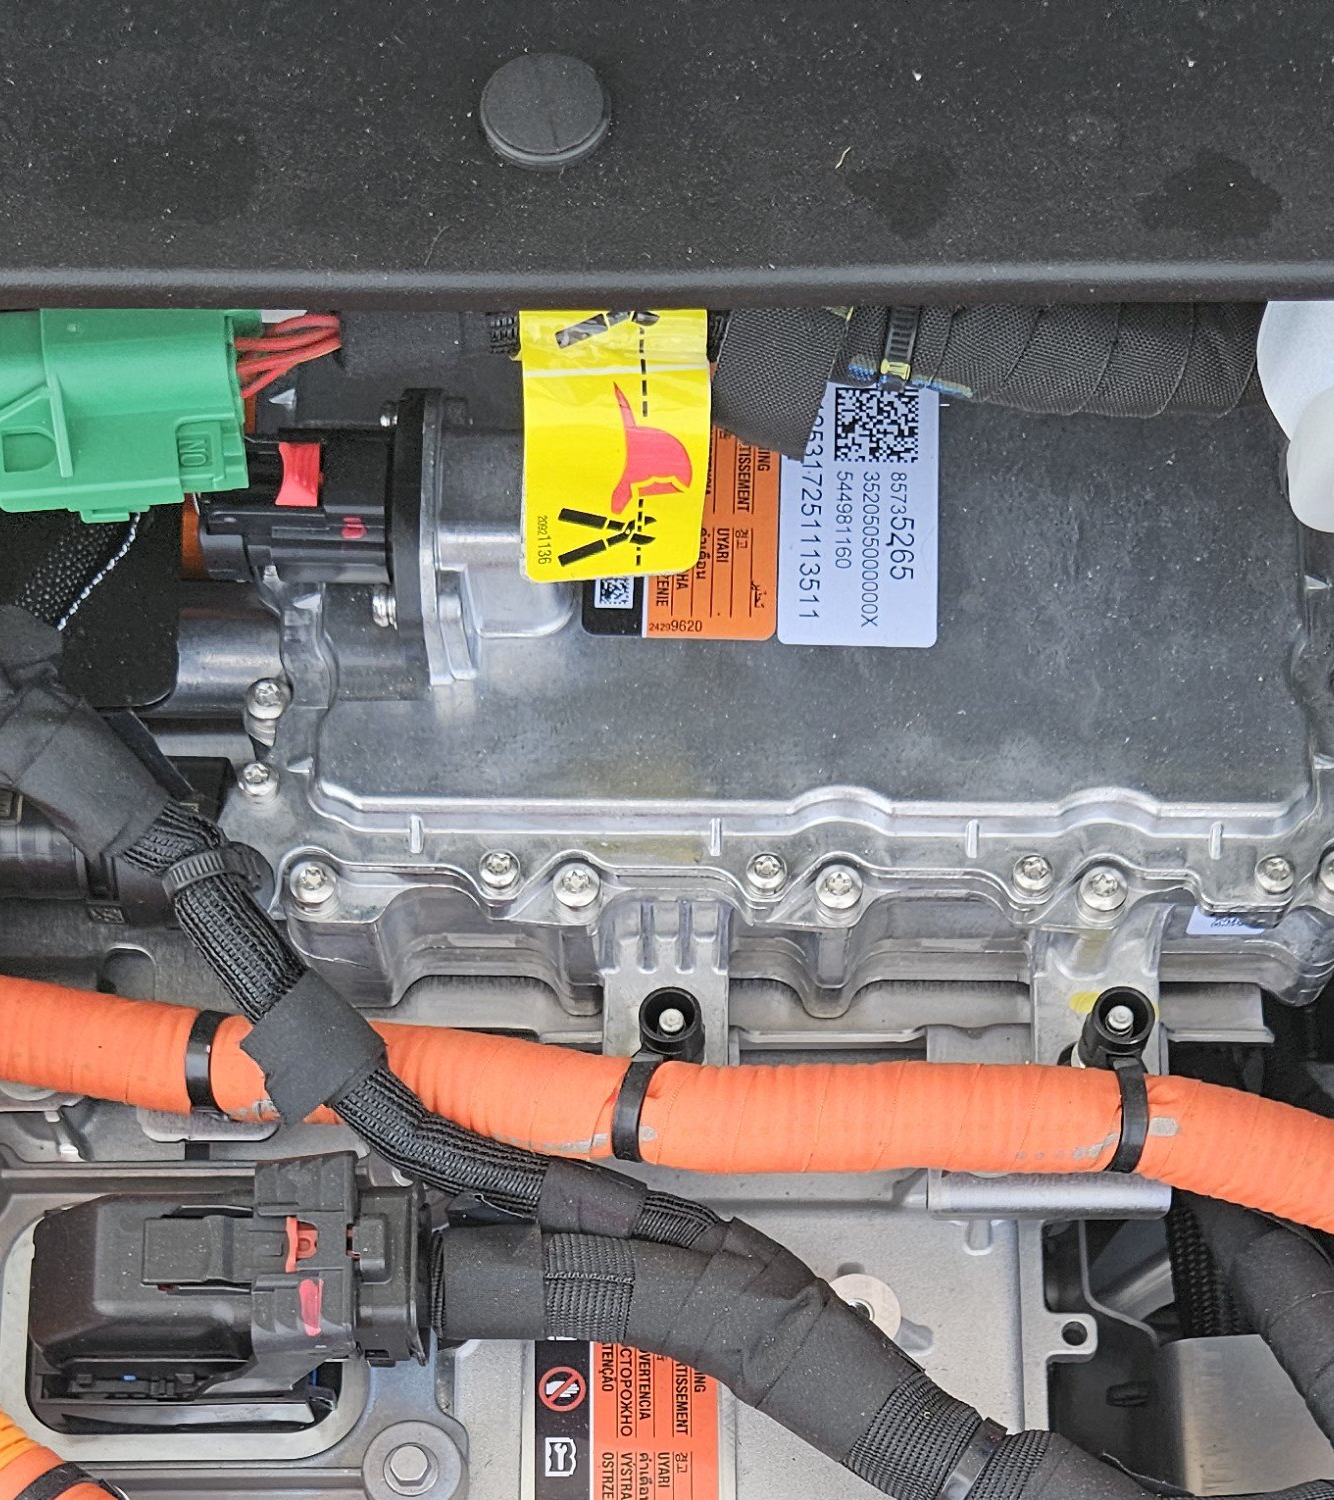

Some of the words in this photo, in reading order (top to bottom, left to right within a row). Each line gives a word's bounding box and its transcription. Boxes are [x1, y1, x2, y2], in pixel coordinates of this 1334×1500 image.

[537, 515, 552, 565] 20921136
[835, 471, 853, 569] 544981160
[717, 528, 729, 563] UYARI
[620, 1348, 633, 1437] СТОРОЖНО
[658, 1452, 670, 1488] UYARI
